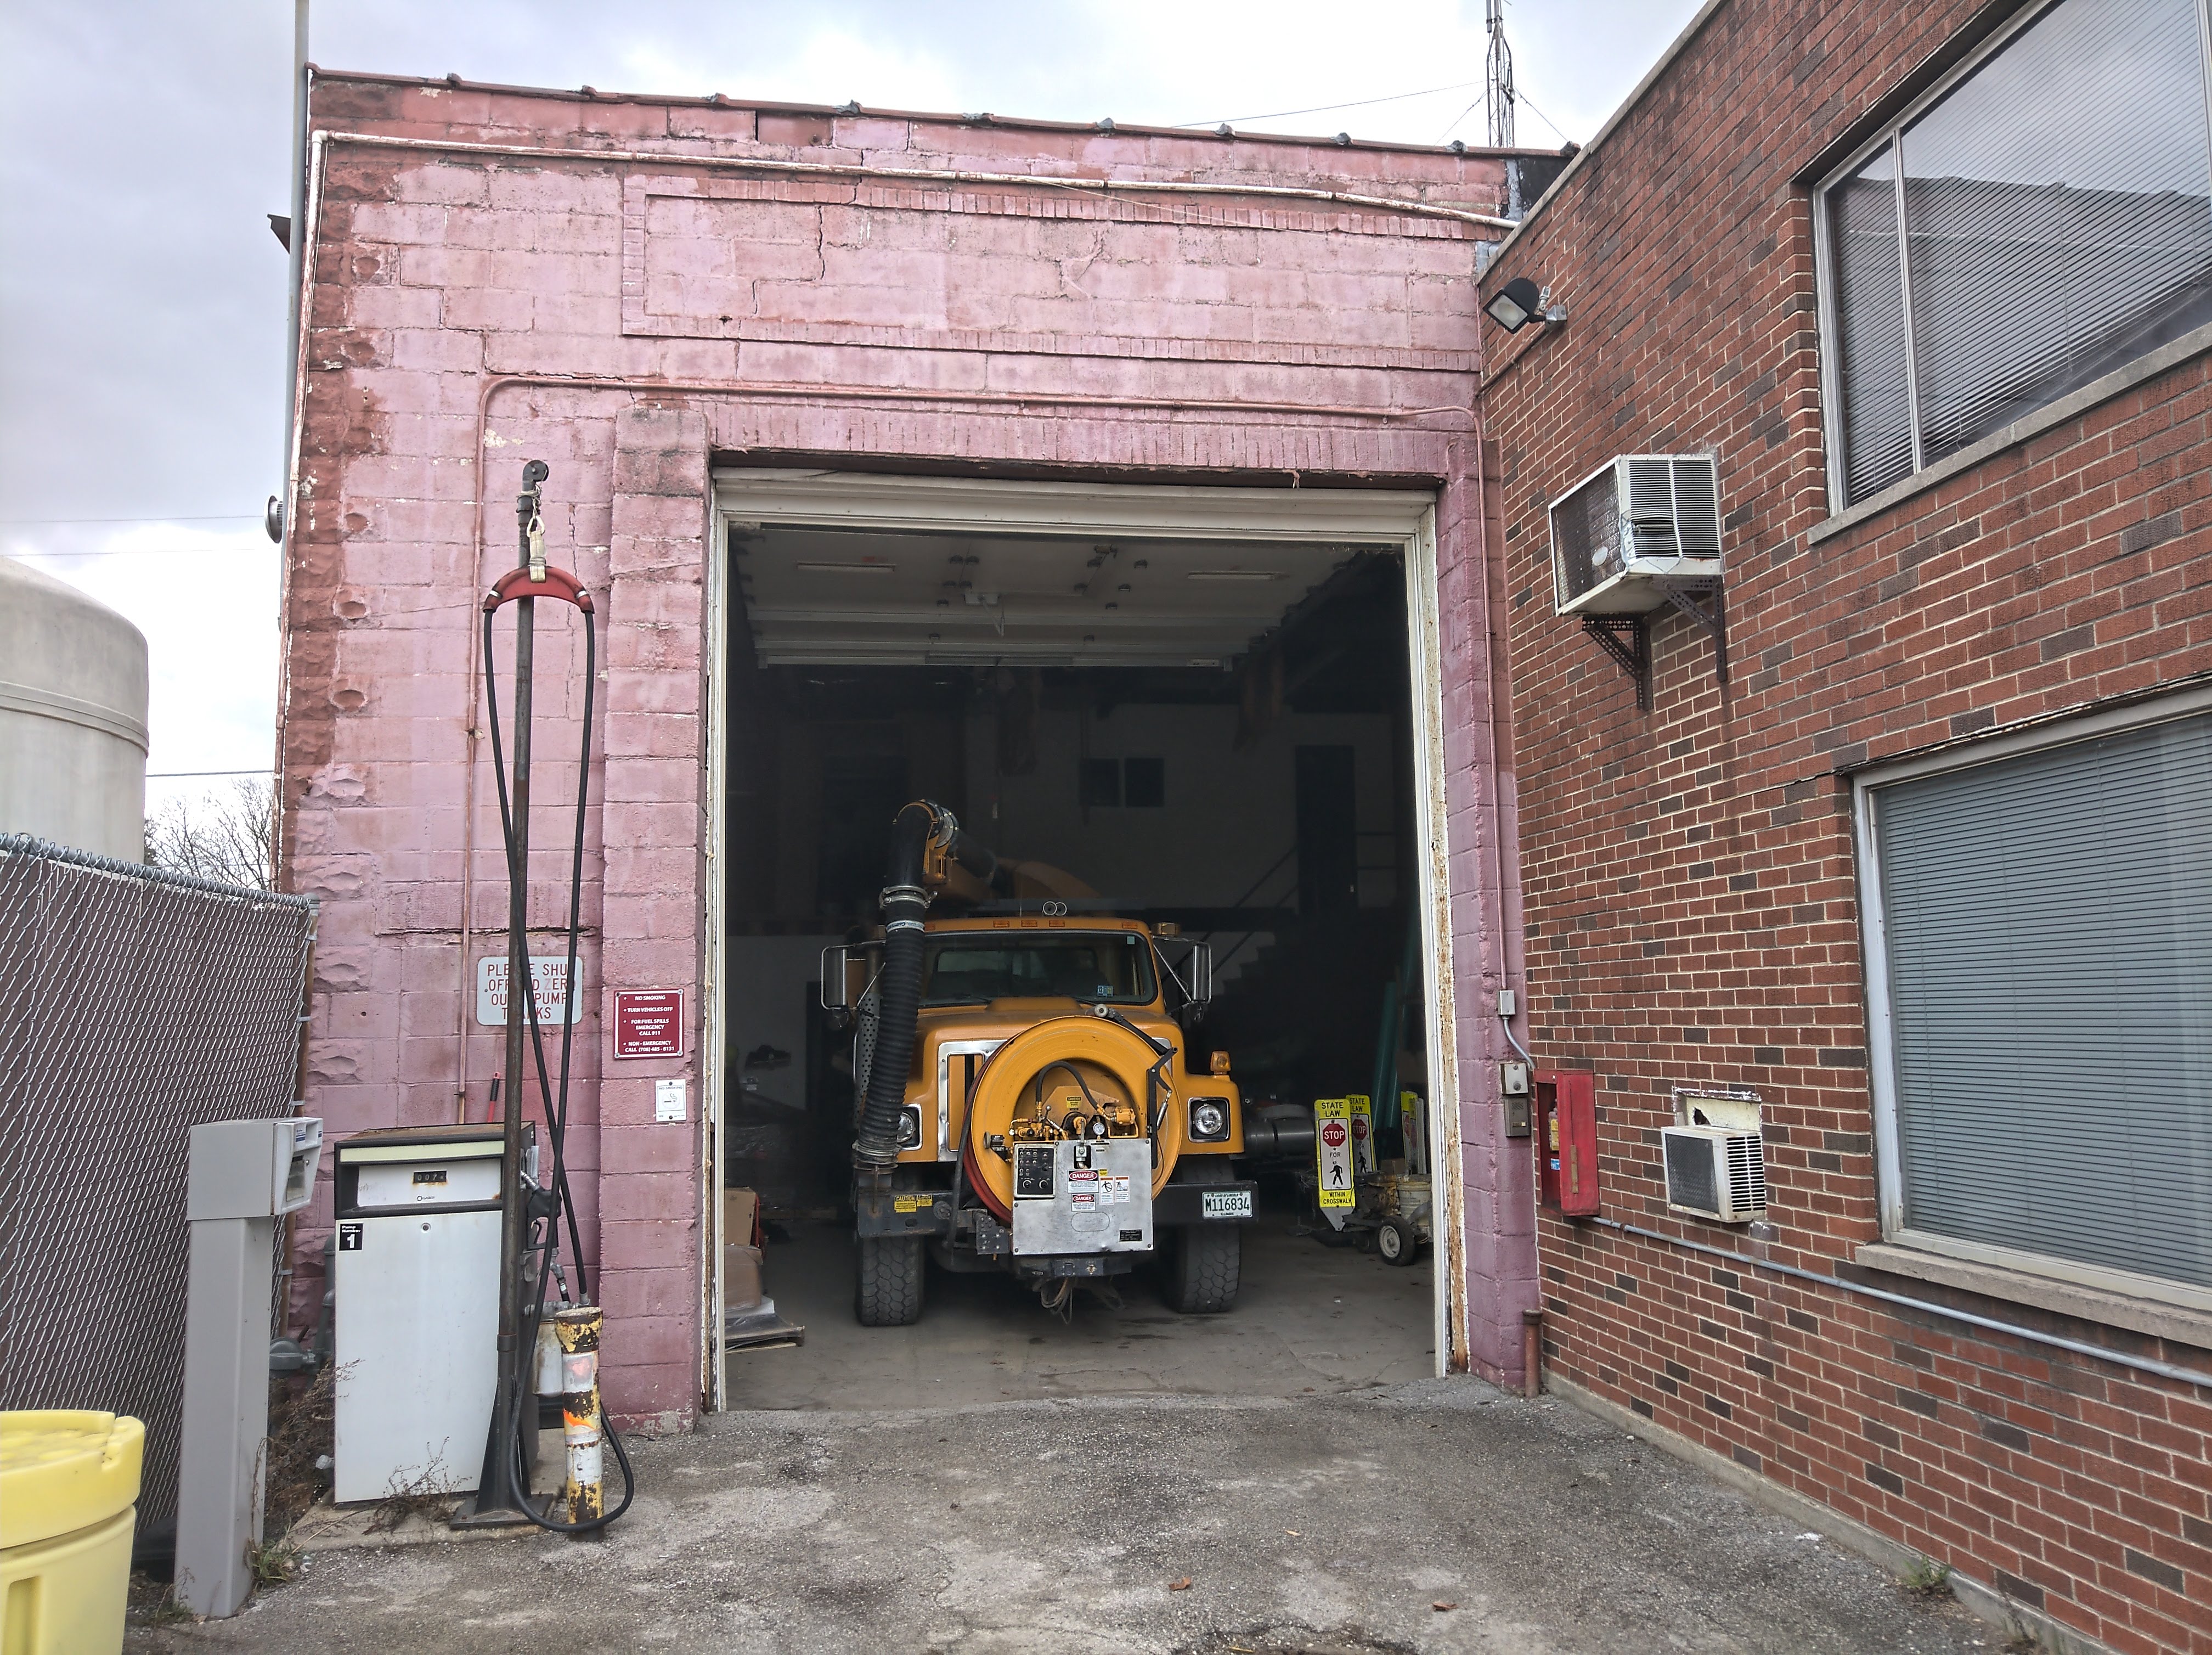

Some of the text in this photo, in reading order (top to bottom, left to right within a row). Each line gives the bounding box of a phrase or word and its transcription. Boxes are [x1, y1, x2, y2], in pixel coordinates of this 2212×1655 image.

[488, 964, 568, 976] PLEE SHU
[544, 978, 575, 990] ZER
[491, 993, 507, 1005] OU
[1324, 1130, 1344, 1140] STOP
[1352, 1125, 1365, 1134] STOP
[1205, 1197, 1249, 1212] M116834
[347, 1234, 355, 1248] 1
